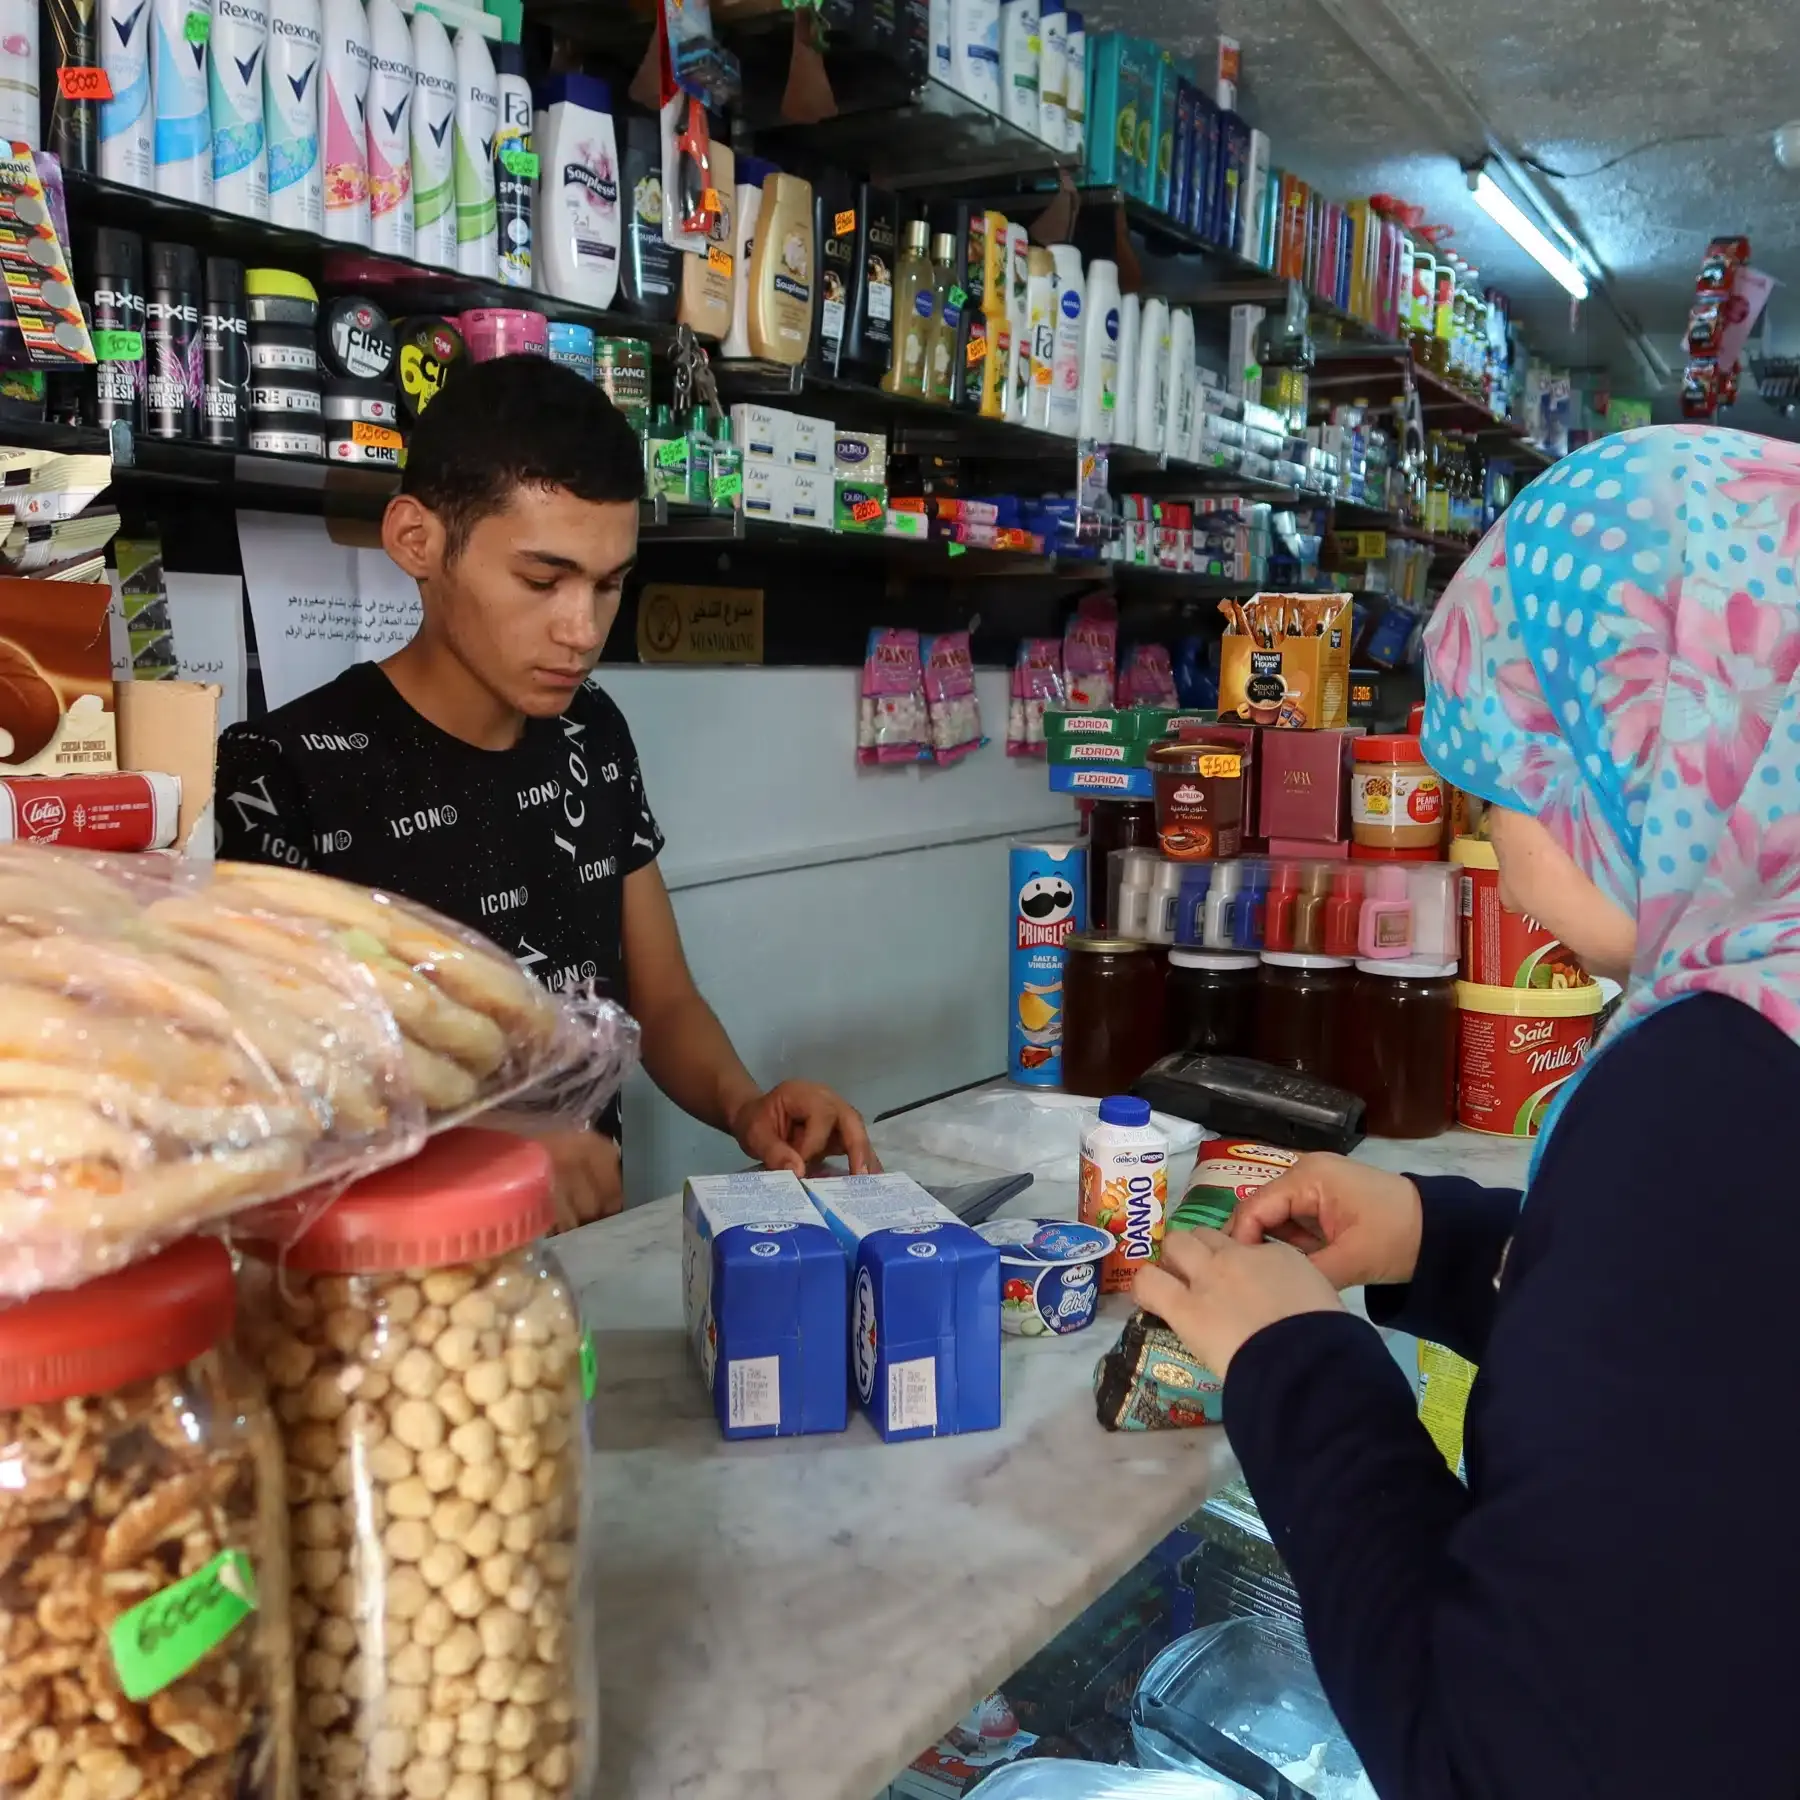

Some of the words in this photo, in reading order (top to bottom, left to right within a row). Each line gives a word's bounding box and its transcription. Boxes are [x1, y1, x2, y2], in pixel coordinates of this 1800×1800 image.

[346, 40, 370, 60] Rex
[415, 72, 456, 92] Rexon
[505, 92, 530, 127] Fa
[566, 166, 617, 197] Souplesse
[94, 290, 145, 312] AXE
[147, 303, 198, 323] AXE
[202, 316, 247, 335] AXE
[349, 327, 392, 360] CIRE
[1036, 325, 1053, 359] Fa
[97, 383, 135, 400] FRESH
[218, 393, 236, 404] STOP
[149, 393, 184, 409] FRESH
[751, 411, 772, 424] Dove
[796, 420, 815, 433] Dove
[837, 444, 867, 456] DURU
[748, 468, 769, 481] Dove
[795, 475, 814, 488] Dove
[1253, 653, 1281, 661] Maxwell
[1255, 660, 1278, 668] House
[1253, 681, 1280, 691] Smooth
[1068, 720, 1109, 729] FLORIDA
[61, 741, 81, 752] COCOA
[83, 740, 106, 751] COOKIES
[301, 734, 352, 751] ICON
[92, 751, 112, 762] CREAM
[1074, 747, 1120, 757] FLORIDA
[1077, 774, 1124, 785] FLORIDA
[1284, 770, 1312, 785] ZARA
[1416, 796, 1440, 807] PEANUT
[30, 802, 61, 823] Lotus
[391, 807, 442, 839] ICON
[579, 859, 611, 883] ICON
[480, 889, 520, 915] ICON
[1028, 961, 1064, 969] VINEGAR
[1509, 1020, 1554, 1049] Saïd
[1527, 1049, 1572, 1074] Mille
[1115, 1153, 1137, 1164] délice
[1126, 1176, 1152, 1258] DANAO
[1066, 1268, 1092, 1283] دليس
